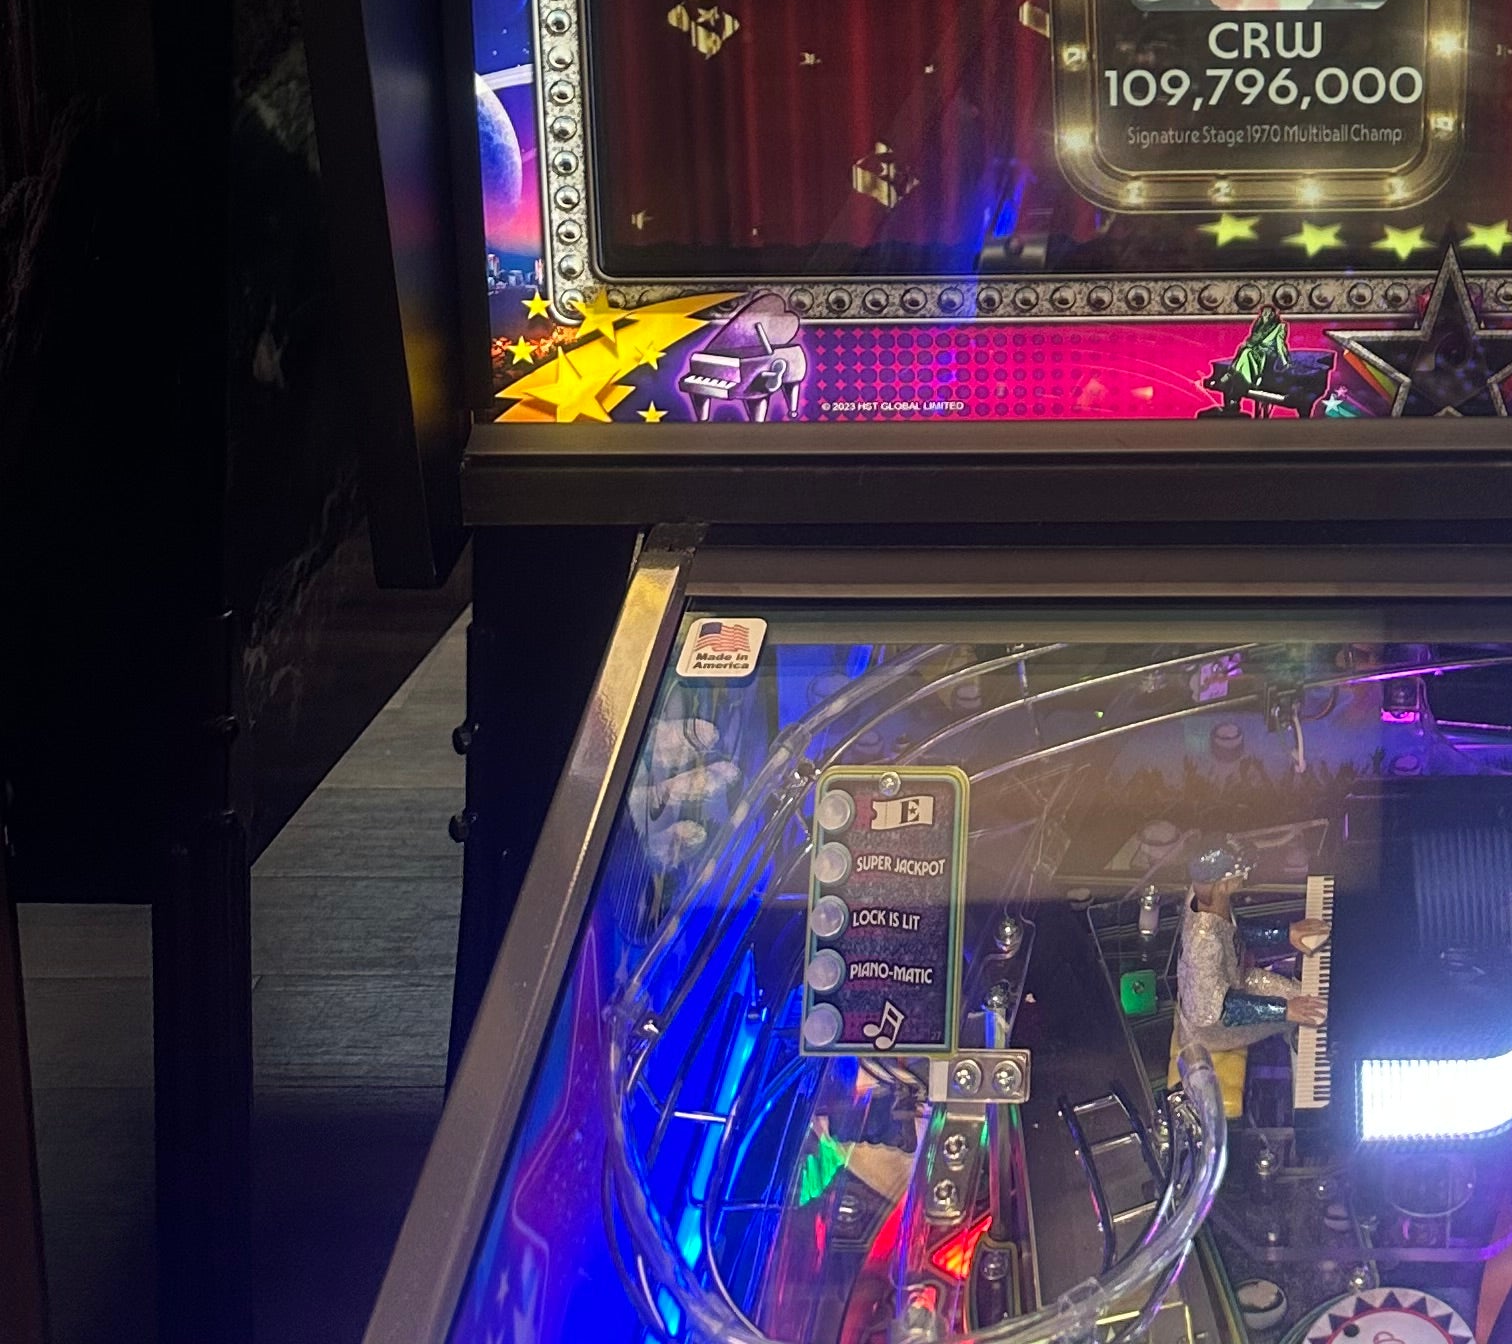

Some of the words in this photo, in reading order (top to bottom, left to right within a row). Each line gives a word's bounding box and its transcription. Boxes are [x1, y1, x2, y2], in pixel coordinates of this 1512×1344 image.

[1208, 21, 1323, 59] CRW
[1104, 66, 1424, 112] 109,796,000
[1127, 125, 1200, 149] Signature
[1202, 125, 1245, 147] Stage
[1247, 125, 1281, 143] 1970
[1284, 124, 1349, 143] Multiball
[1351, 124, 1402, 145] Champ
[832, 402, 856, 411] 2023
[857, 402, 878, 410] HST
[880, 402, 920, 410] GLOBAL
[923, 402, 965, 410] LIMITED
[693, 661, 750, 669] America
[696, 653, 732, 661] Made
[857, 855, 892, 872] SUPER
[894, 858, 946, 876] JACKPOT
[852, 909, 886, 927] LOCK
[889, 911, 900, 928] IS
[902, 913, 921, 931] LIT
[850, 962, 933, 984] PIANO-MATIC
